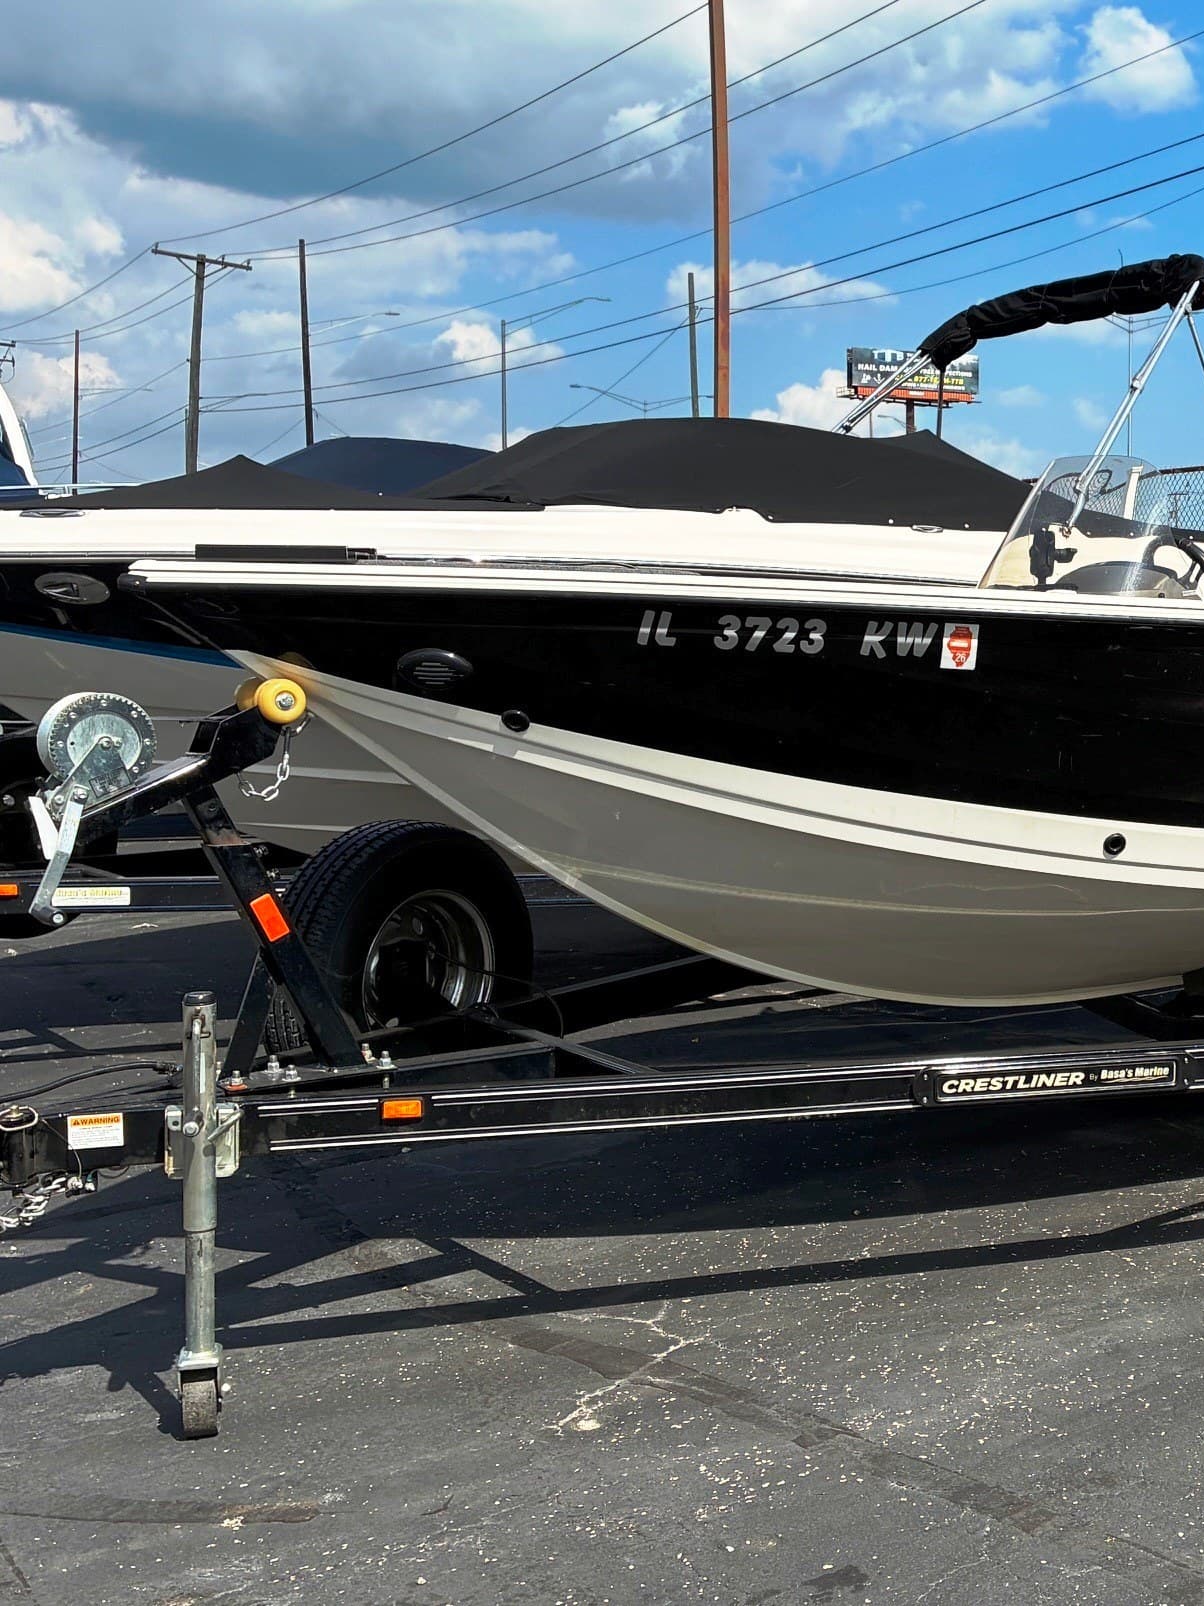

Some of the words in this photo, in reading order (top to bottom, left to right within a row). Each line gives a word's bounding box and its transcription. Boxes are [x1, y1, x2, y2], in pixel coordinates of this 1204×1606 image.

[858, 363, 878, 371] HAIL
[636, 609, 677, 647] IL
[713, 614, 828, 655] 3723
[860, 620, 939, 659] KW
[954, 652, 966, 663] 26
[942, 1071, 1085, 1094] CRESTLINER
[1089, 1073, 1098, 1082] By
[80, 1116, 119, 1126] WARNING
